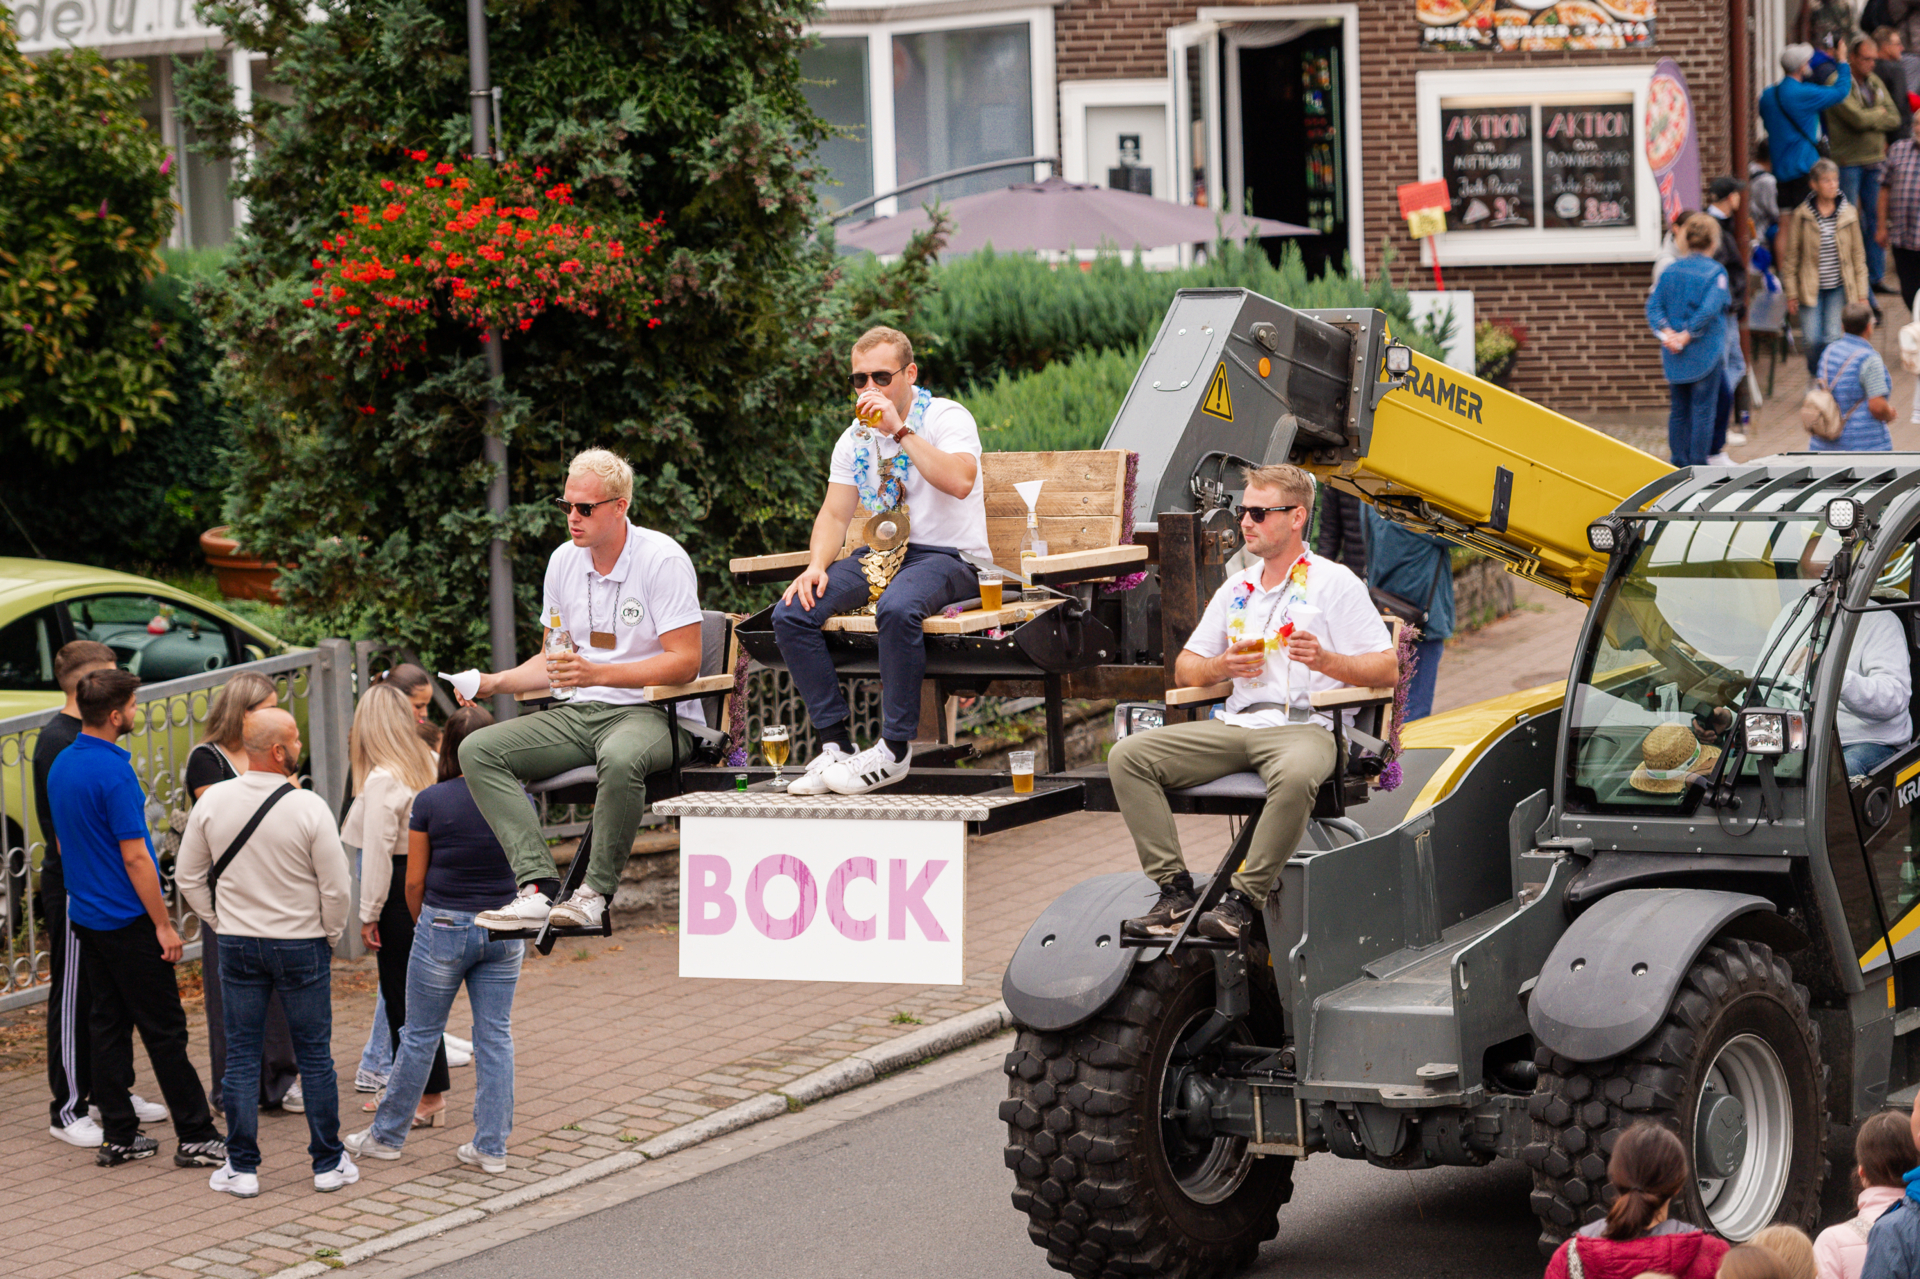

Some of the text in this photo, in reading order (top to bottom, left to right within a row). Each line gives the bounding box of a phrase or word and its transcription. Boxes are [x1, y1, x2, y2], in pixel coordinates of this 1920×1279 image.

[1424, 22, 1649, 41] PIZZA BURGER PASTA
[1446, 114, 1527, 140] AKTION
[1547, 112, 1630, 138] AKTION
[1388, 365, 1483, 425] RAMER
[687, 854, 950, 942] BOCK
